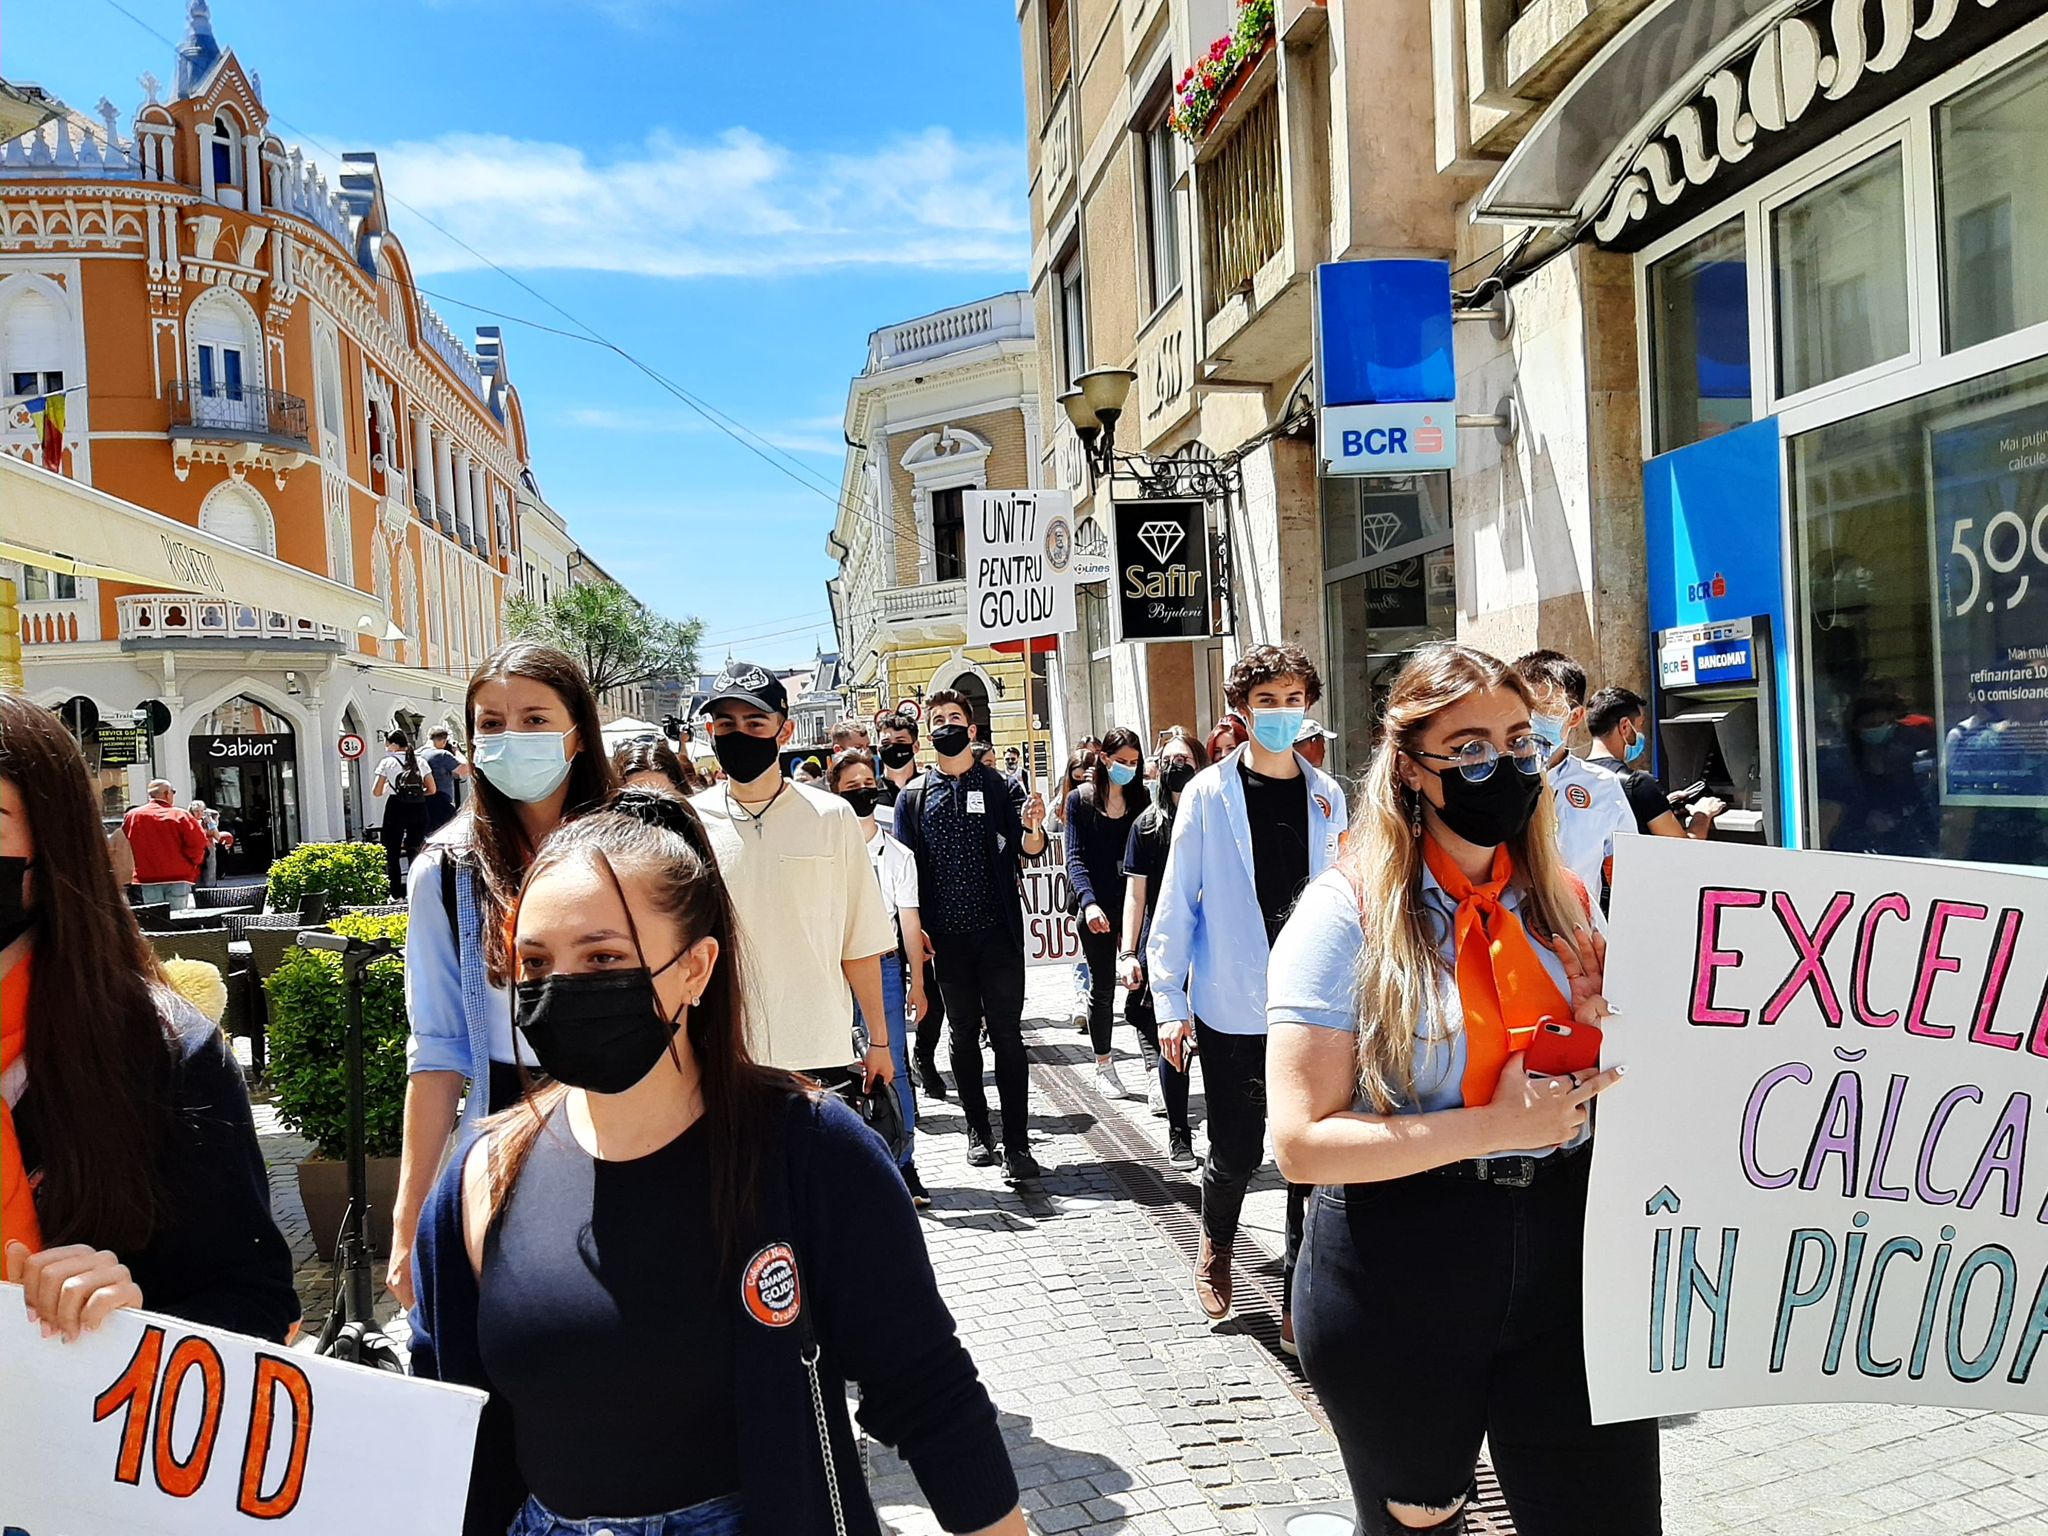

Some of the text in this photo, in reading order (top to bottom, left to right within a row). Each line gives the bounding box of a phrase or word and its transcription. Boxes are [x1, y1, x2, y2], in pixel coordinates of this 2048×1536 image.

[1342, 427, 1408, 457] BCR
[2000, 438, 2019, 452] Mai
[978, 554, 1042, 588] PENTRU
[1126, 564, 1202, 599] Safir
[1688, 581, 1711, 602] BCR
[980, 586, 1054, 628] GOJDU
[1663, 661, 1680, 674] BCR
[1698, 651, 1746, 670] BANCOMAT
[2007, 646, 2027, 661] Mai
[208, 736, 274, 757] Sabion
[1030, 916, 1079, 959] SUS
[1738, 1045, 2048, 1224] CĂLCA
[761, 1277, 795, 1302] GOJDU
[1645, 1184, 1739, 1374] ÎN
[93, 1324, 314, 1520] 10 D
